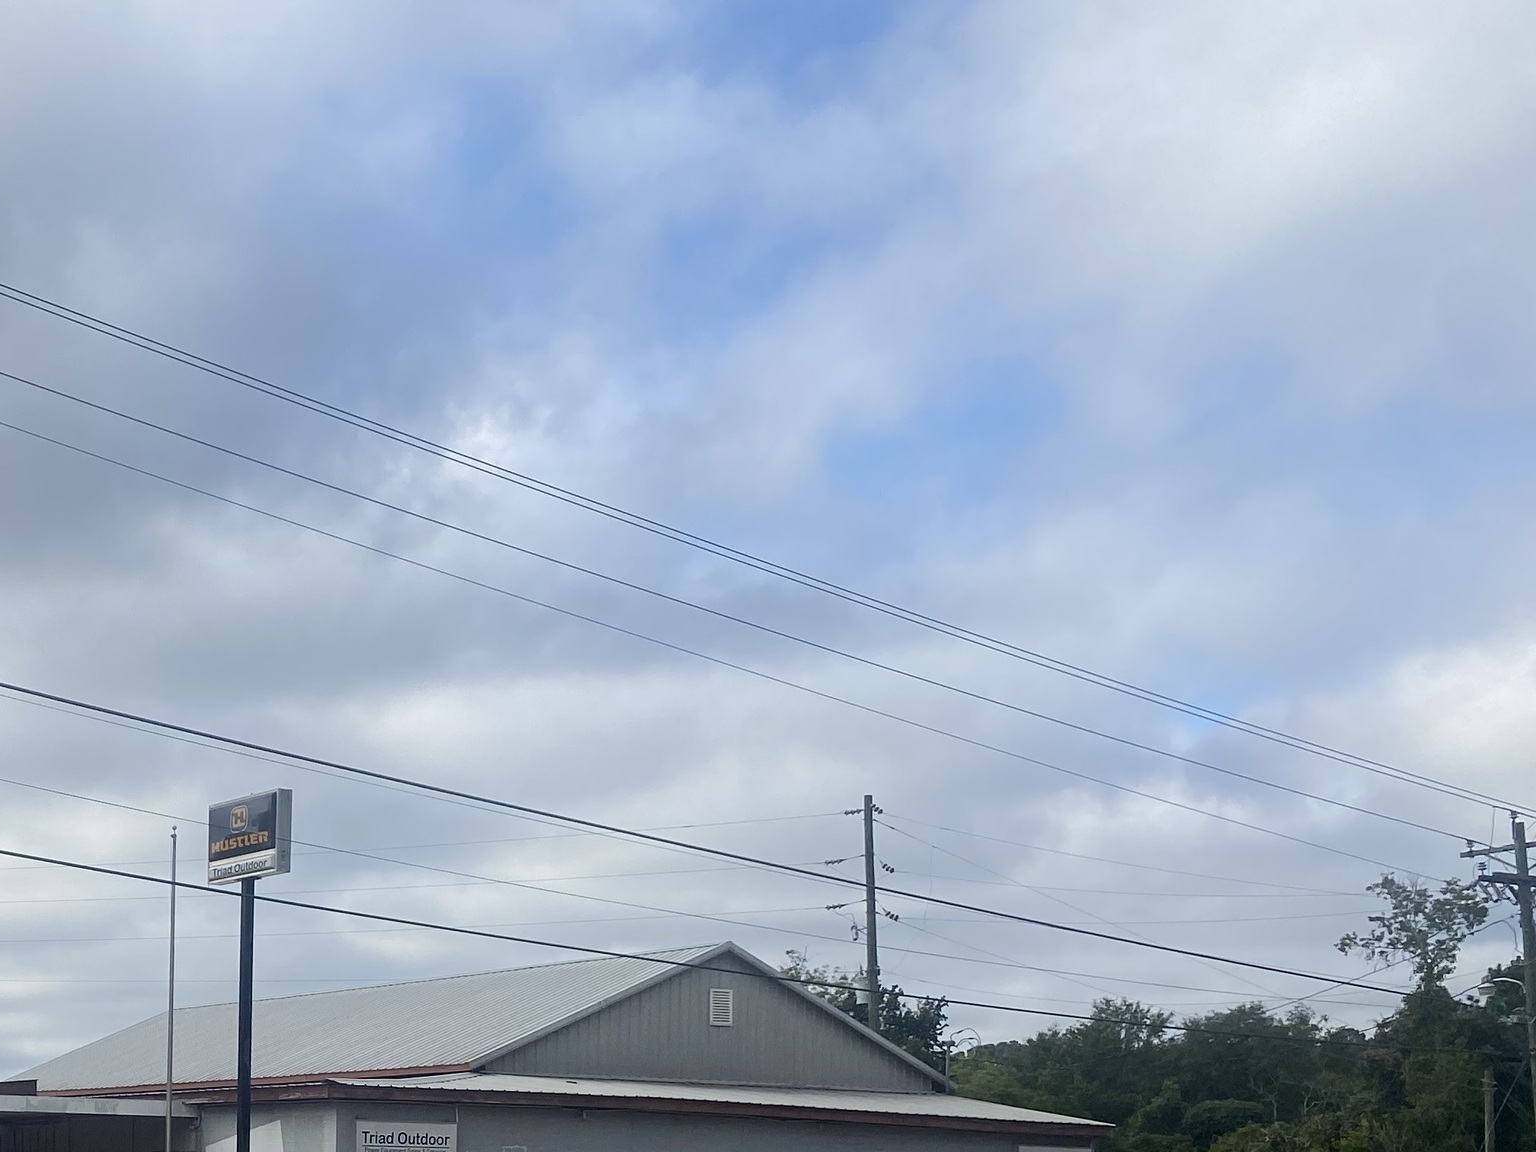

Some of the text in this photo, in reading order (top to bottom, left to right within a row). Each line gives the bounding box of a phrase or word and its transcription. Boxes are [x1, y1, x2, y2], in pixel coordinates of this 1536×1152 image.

[211, 831, 269, 854] HUSTLER
[212, 860, 268, 878] Triad Outdoor
[362, 1131, 451, 1146] Triad Outdoor
